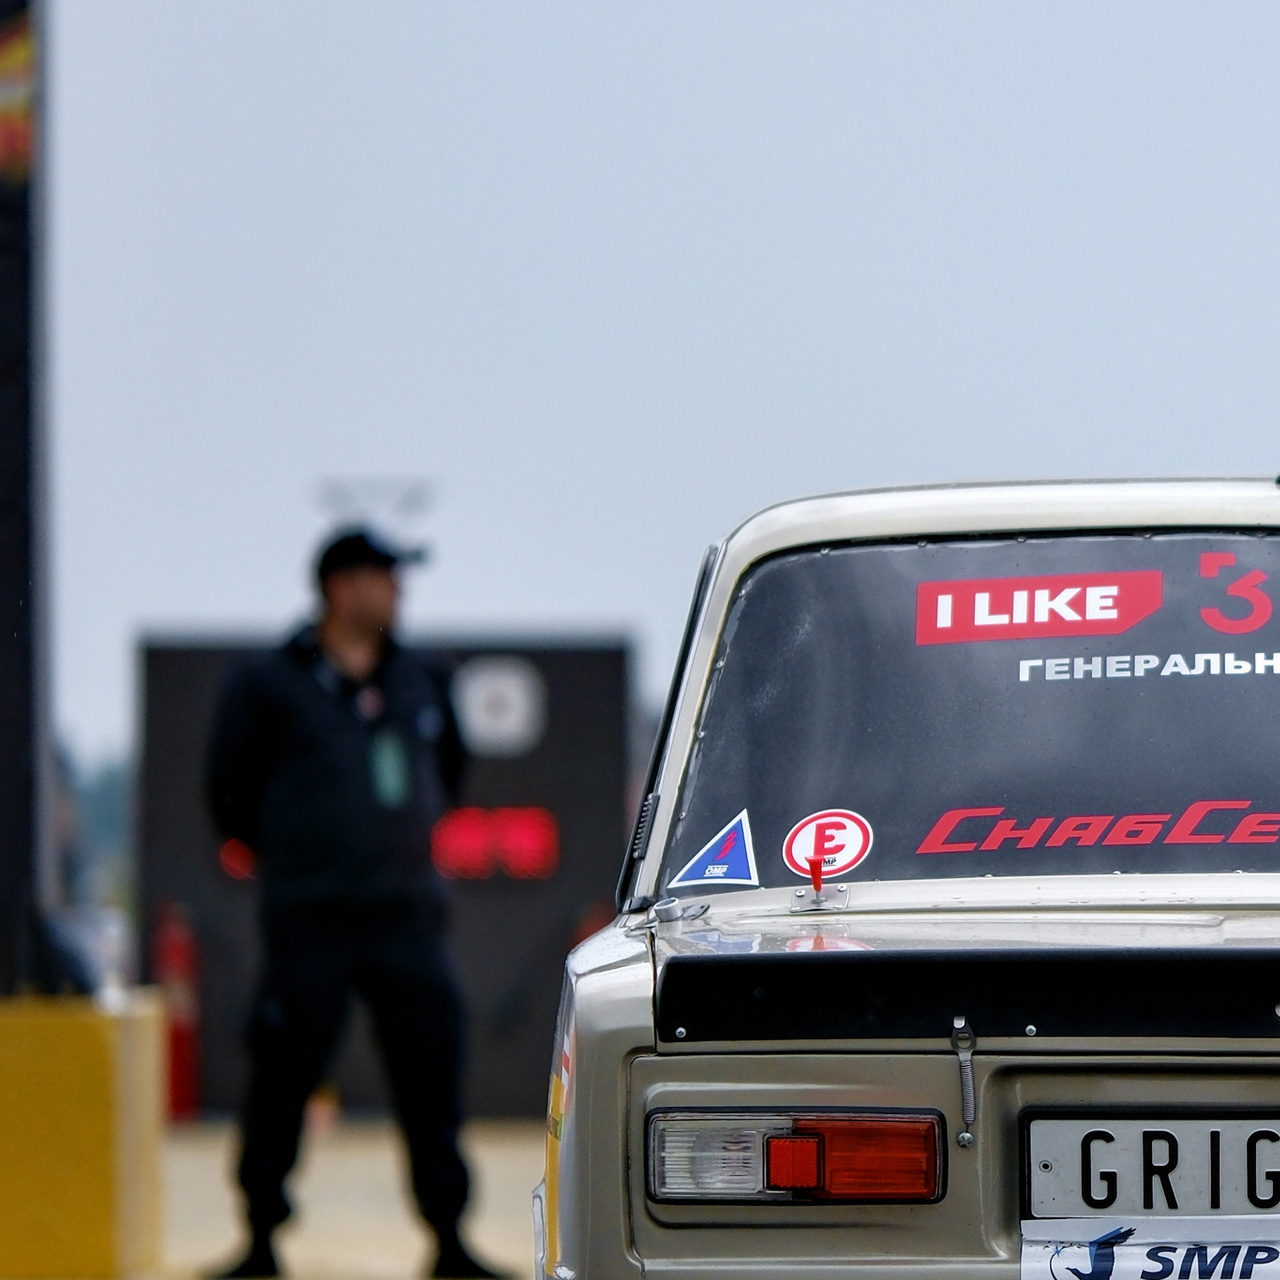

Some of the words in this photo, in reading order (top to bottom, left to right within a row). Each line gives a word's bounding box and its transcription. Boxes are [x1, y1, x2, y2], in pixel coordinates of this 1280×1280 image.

[937, 594, 951, 628] I
[974, 585, 1118, 626] LIKE
[814, 821, 847, 856] E
[1140, 1244, 1280, 1280] SMP
